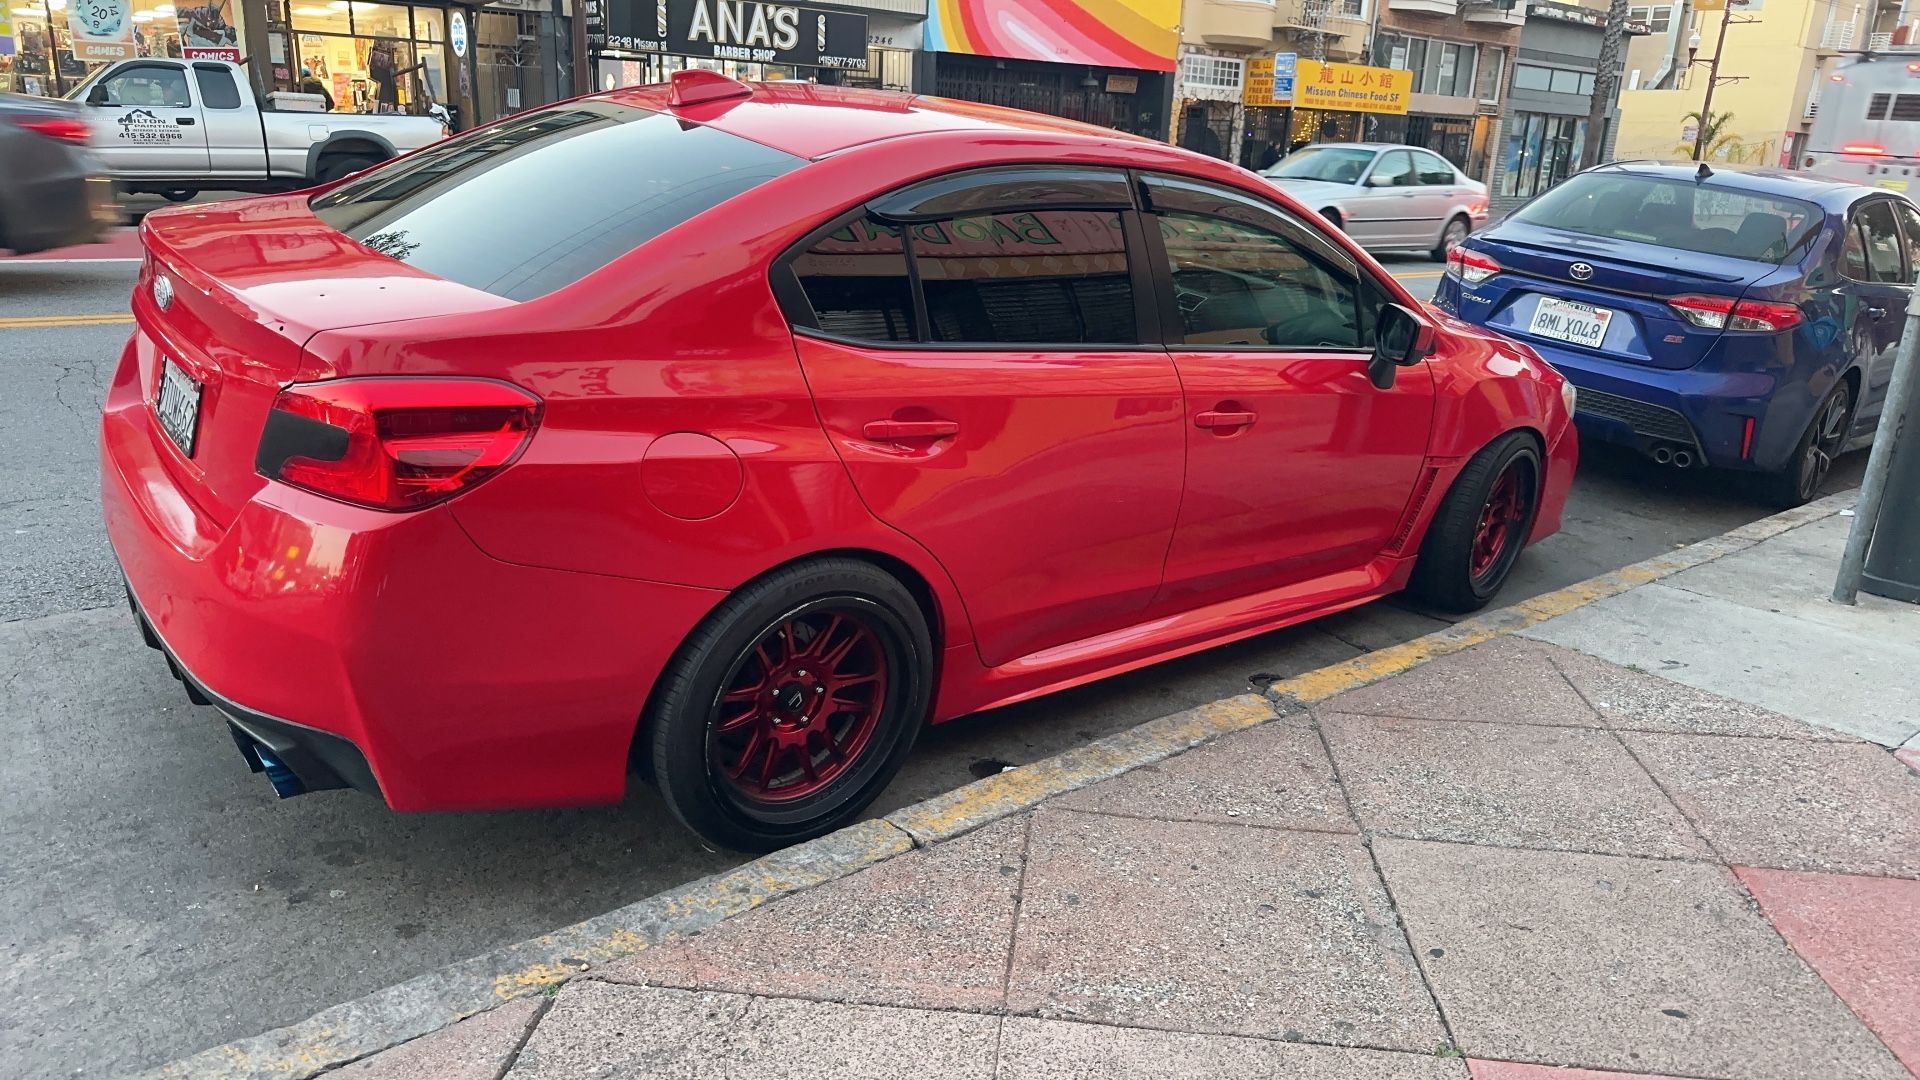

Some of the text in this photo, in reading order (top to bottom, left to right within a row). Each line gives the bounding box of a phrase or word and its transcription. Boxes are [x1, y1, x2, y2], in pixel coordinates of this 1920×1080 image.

[91, 5, 107, 20] 20
[92, 20, 100, 29] 8
[687, 0, 799, 50] ANA'S
[608, 35, 632, 49] 2248
[869, 35, 893, 45] 2246
[86, 45, 125, 57] GAMES
[191, 51, 235, 61] COMICS
[713, 44, 776, 62] BARBER SHOP
[1318, 66, 1395, 89] 龍山小館
[1305, 85, 1400, 103] Mission Chinese Food SF
[1537, 312, 1601, 340] 8MLX048
[1568, 334, 1599, 347] TOYOTA
